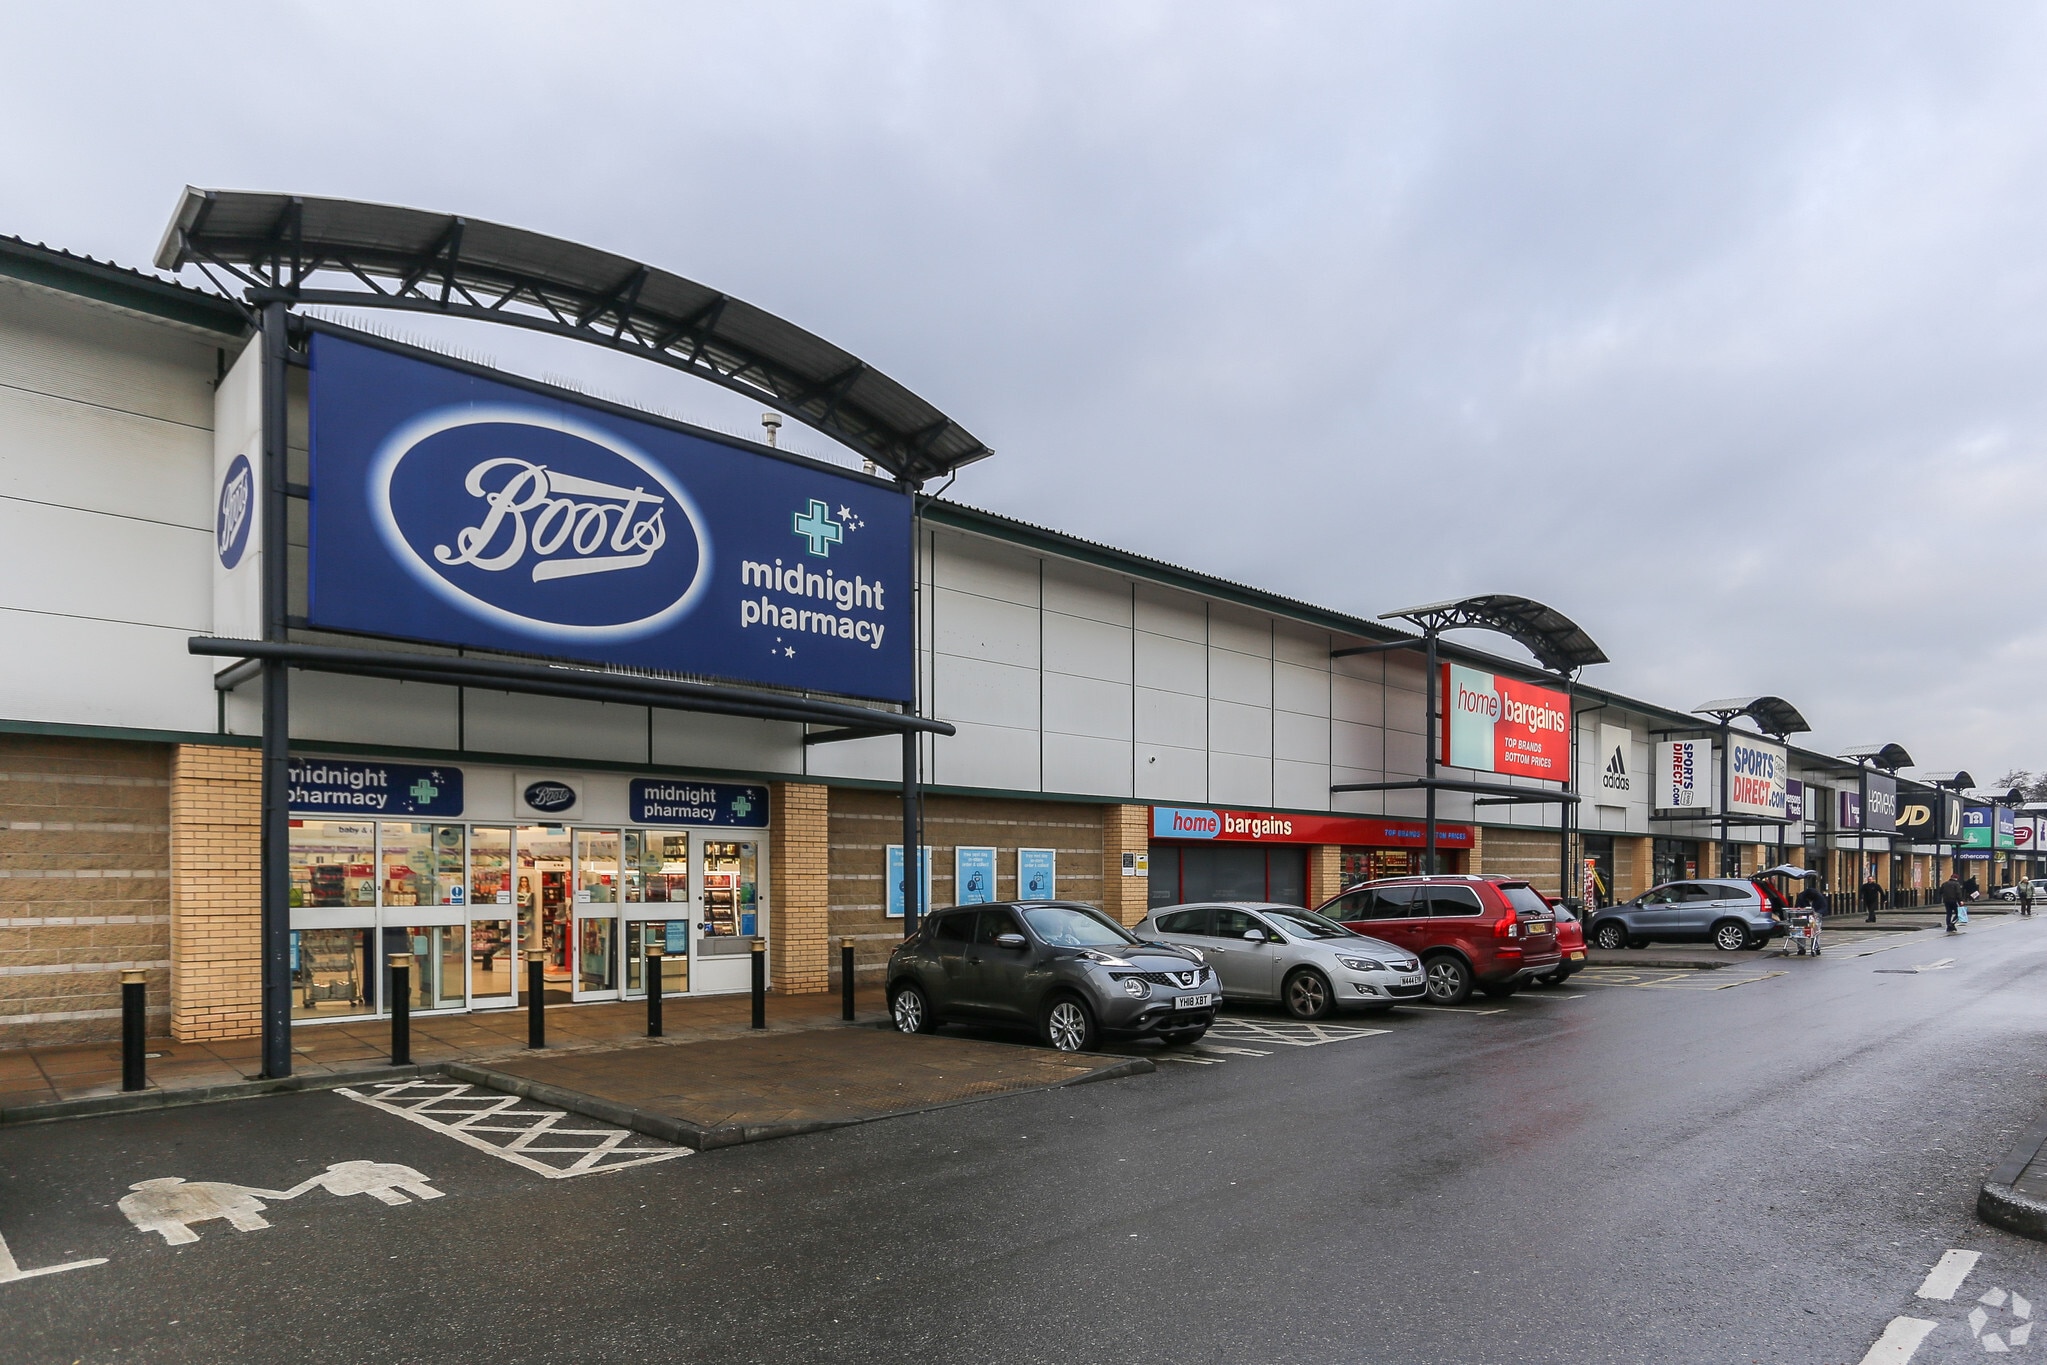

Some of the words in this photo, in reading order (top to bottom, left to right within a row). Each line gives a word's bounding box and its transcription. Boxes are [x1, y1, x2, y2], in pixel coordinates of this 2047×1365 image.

[220, 466, 249, 556] Boots
[434, 456, 667, 583] Boots
[742, 558, 885, 612] midnight
[742, 597, 885, 650] pharmacy
[1458, 682, 1498, 717] home
[1504, 691, 1565, 733] bargains
[1504, 737, 1517, 750] TOP
[1518, 739, 1542, 753] BRANDS
[1504, 752, 1530, 765] BOTTOM
[1531, 755, 1552, 768] PRICES
[1683, 743, 1693, 789] SPORTS
[1733, 745, 1774, 779] SPORTS
[288, 764, 388, 790] midnight
[1602, 774, 1630, 791] adidas
[531, 786, 570, 806] Boots
[644, 785, 717, 805] midnight
[644, 803, 717, 821] pharmacy
[1895, 805, 1931, 826] JD
[339, 826, 360, 835] baby
[1173, 811, 1217, 831] home
[1225, 812, 1293, 838] bargains
[1384, 829, 1397, 837] TOP
